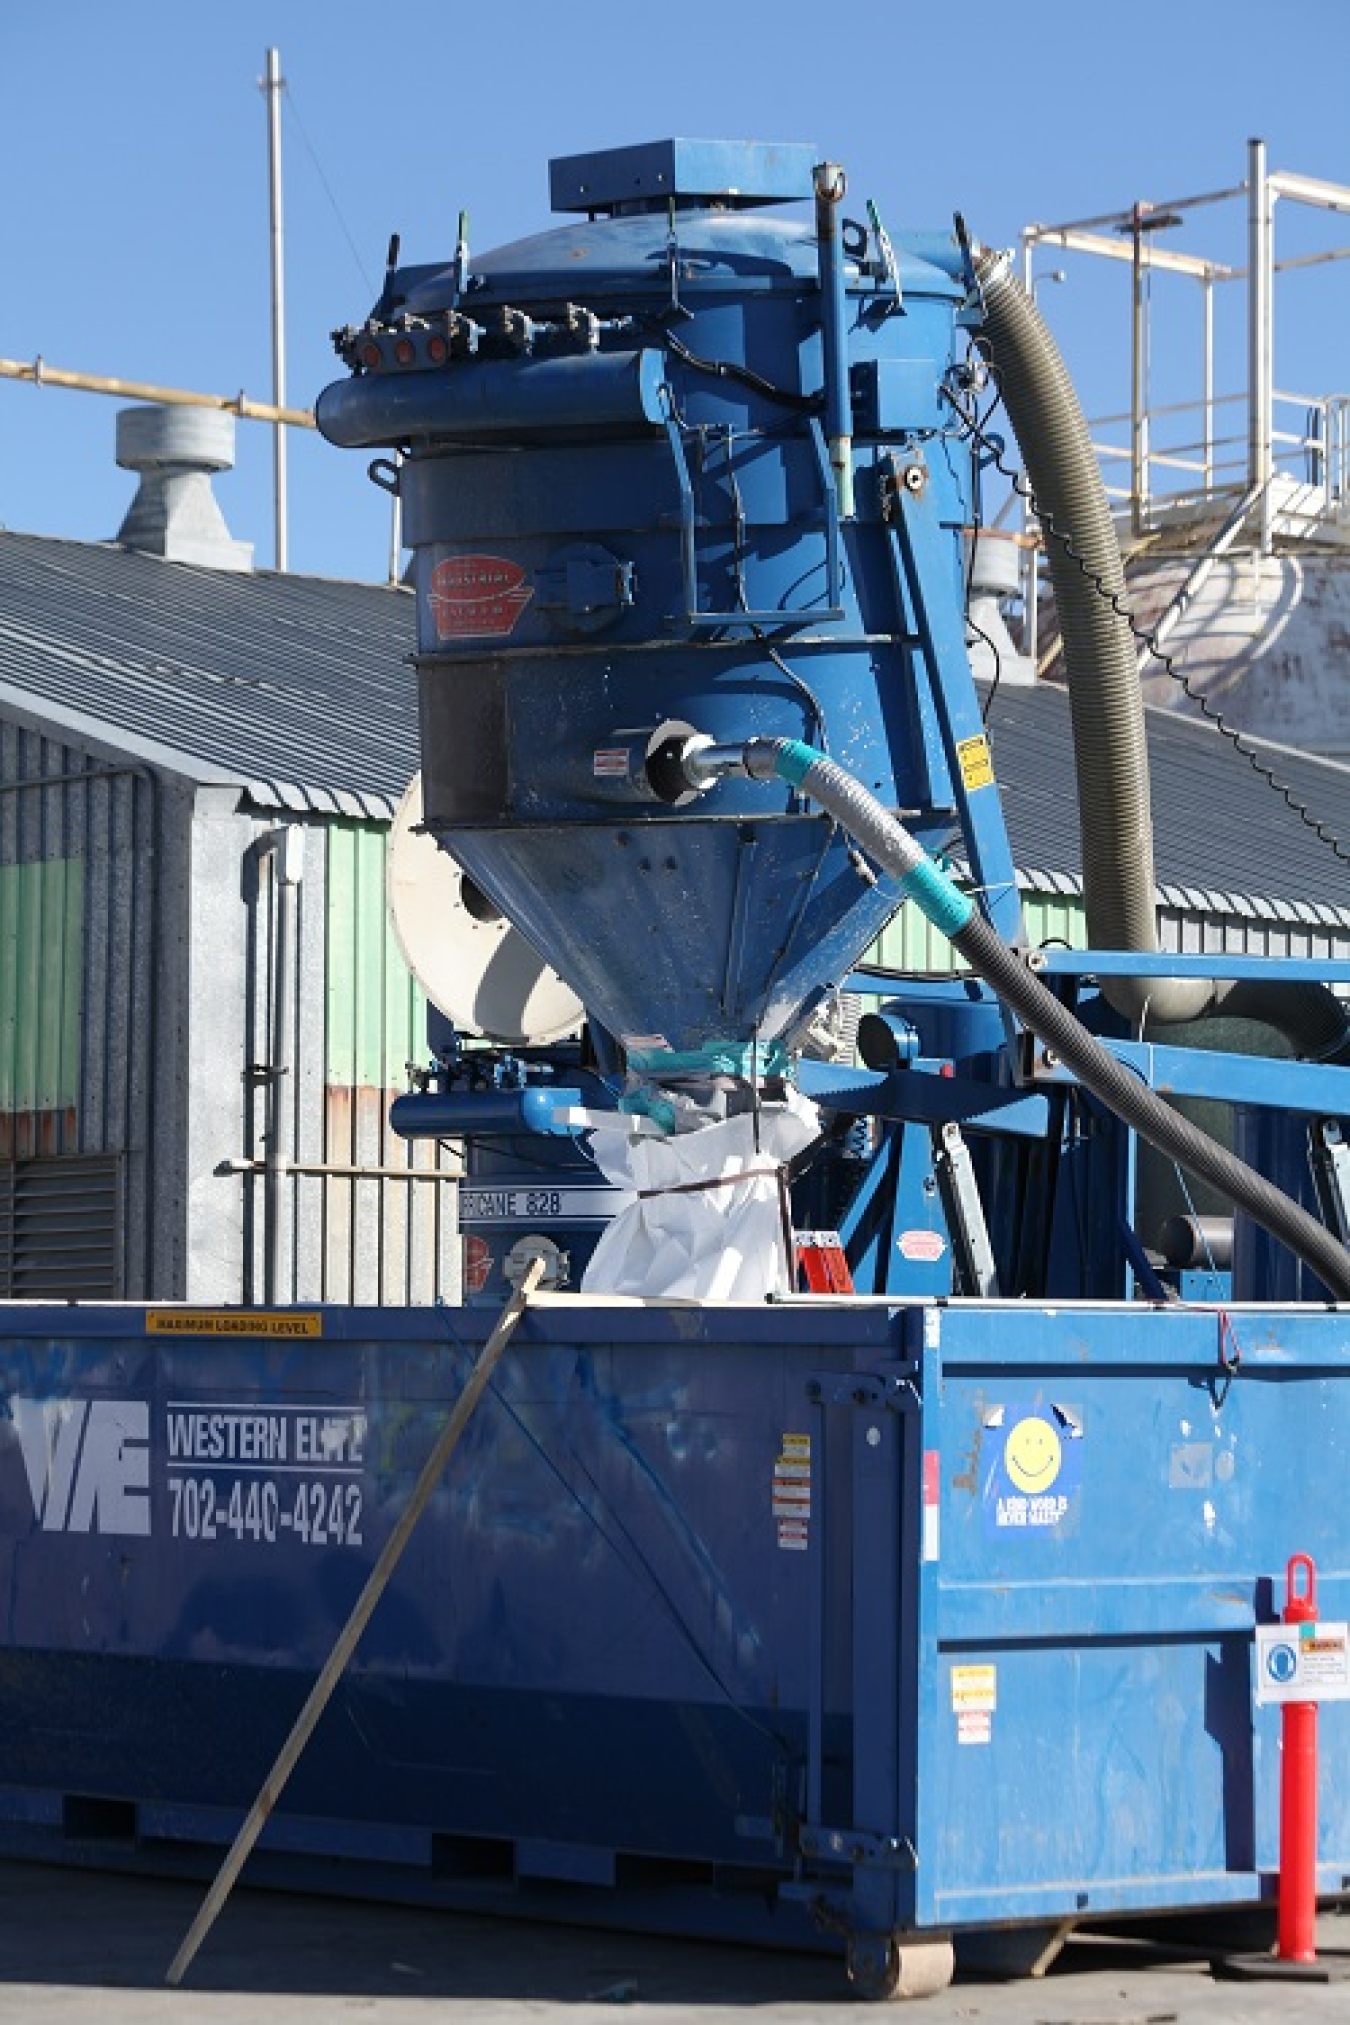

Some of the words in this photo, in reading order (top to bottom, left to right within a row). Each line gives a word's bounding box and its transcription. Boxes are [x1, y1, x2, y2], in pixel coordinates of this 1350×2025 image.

[526, 1192, 562, 1215] 828
[155, 1319, 213, 1331] MAXIMUM
[215, 1319, 268, 1332] LOADING
[271, 1322, 309, 1335] LEVEL
[166, 1414, 287, 1459] WESTERN
[168, 1477, 363, 1545] 702-440-4242
